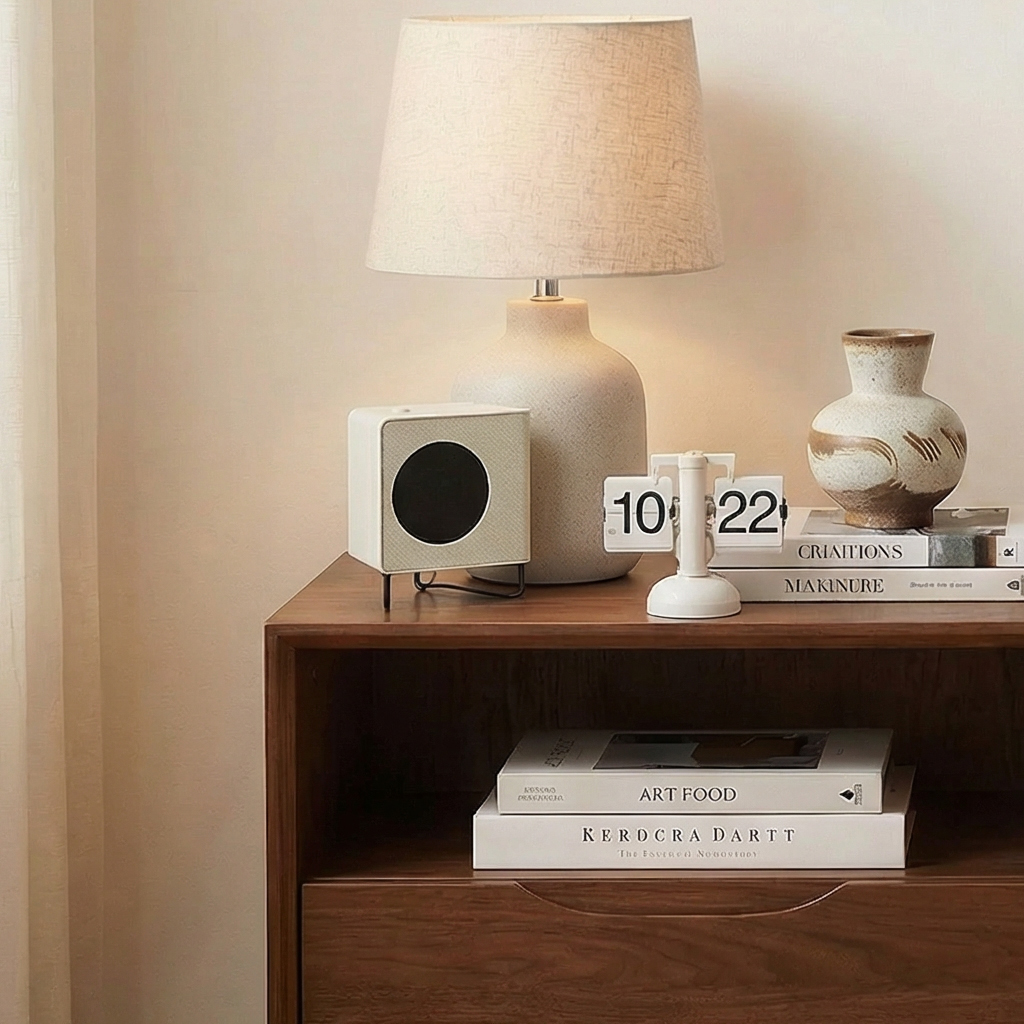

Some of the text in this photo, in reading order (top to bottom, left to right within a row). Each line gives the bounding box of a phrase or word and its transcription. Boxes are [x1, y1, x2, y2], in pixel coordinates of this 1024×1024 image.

[613, 490, 778, 534] 10 22
[639, 787, 736, 802] ART FOOD
